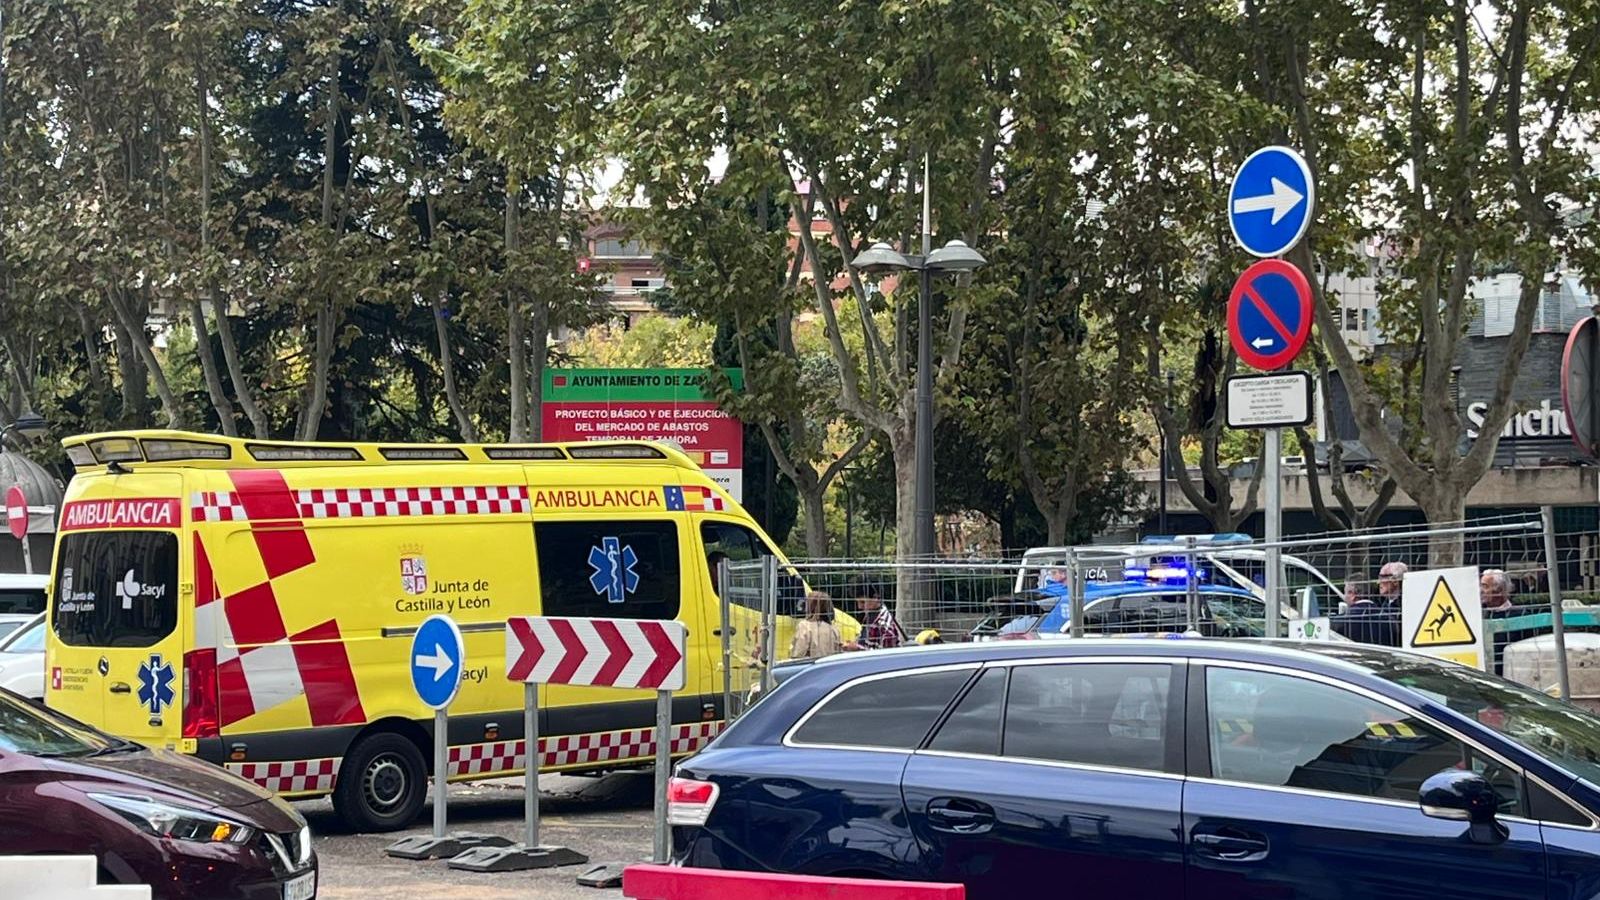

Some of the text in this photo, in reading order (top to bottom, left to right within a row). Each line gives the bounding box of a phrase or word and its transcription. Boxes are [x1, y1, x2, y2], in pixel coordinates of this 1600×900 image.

[571, 375, 661, 387] AYUNTAMIENTO
[664, 375, 680, 387] DE
[555, 409, 608, 419] PROYECTO
[610, 407, 646, 419] BÁSICO
[648, 409, 656, 418] Y
[658, 409, 671, 418] DE
[575, 422, 709, 431] DEL MERCADO DE ABASTOS
[534, 489, 661, 508] AMBULANCIA
[65, 502, 172, 527] AMBULANCIA
[141, 583, 165, 599] Sacyl
[432, 579, 489, 593] Junta de
[395, 596, 490, 614] Castilla y León
[462, 666, 488, 683] acyl
